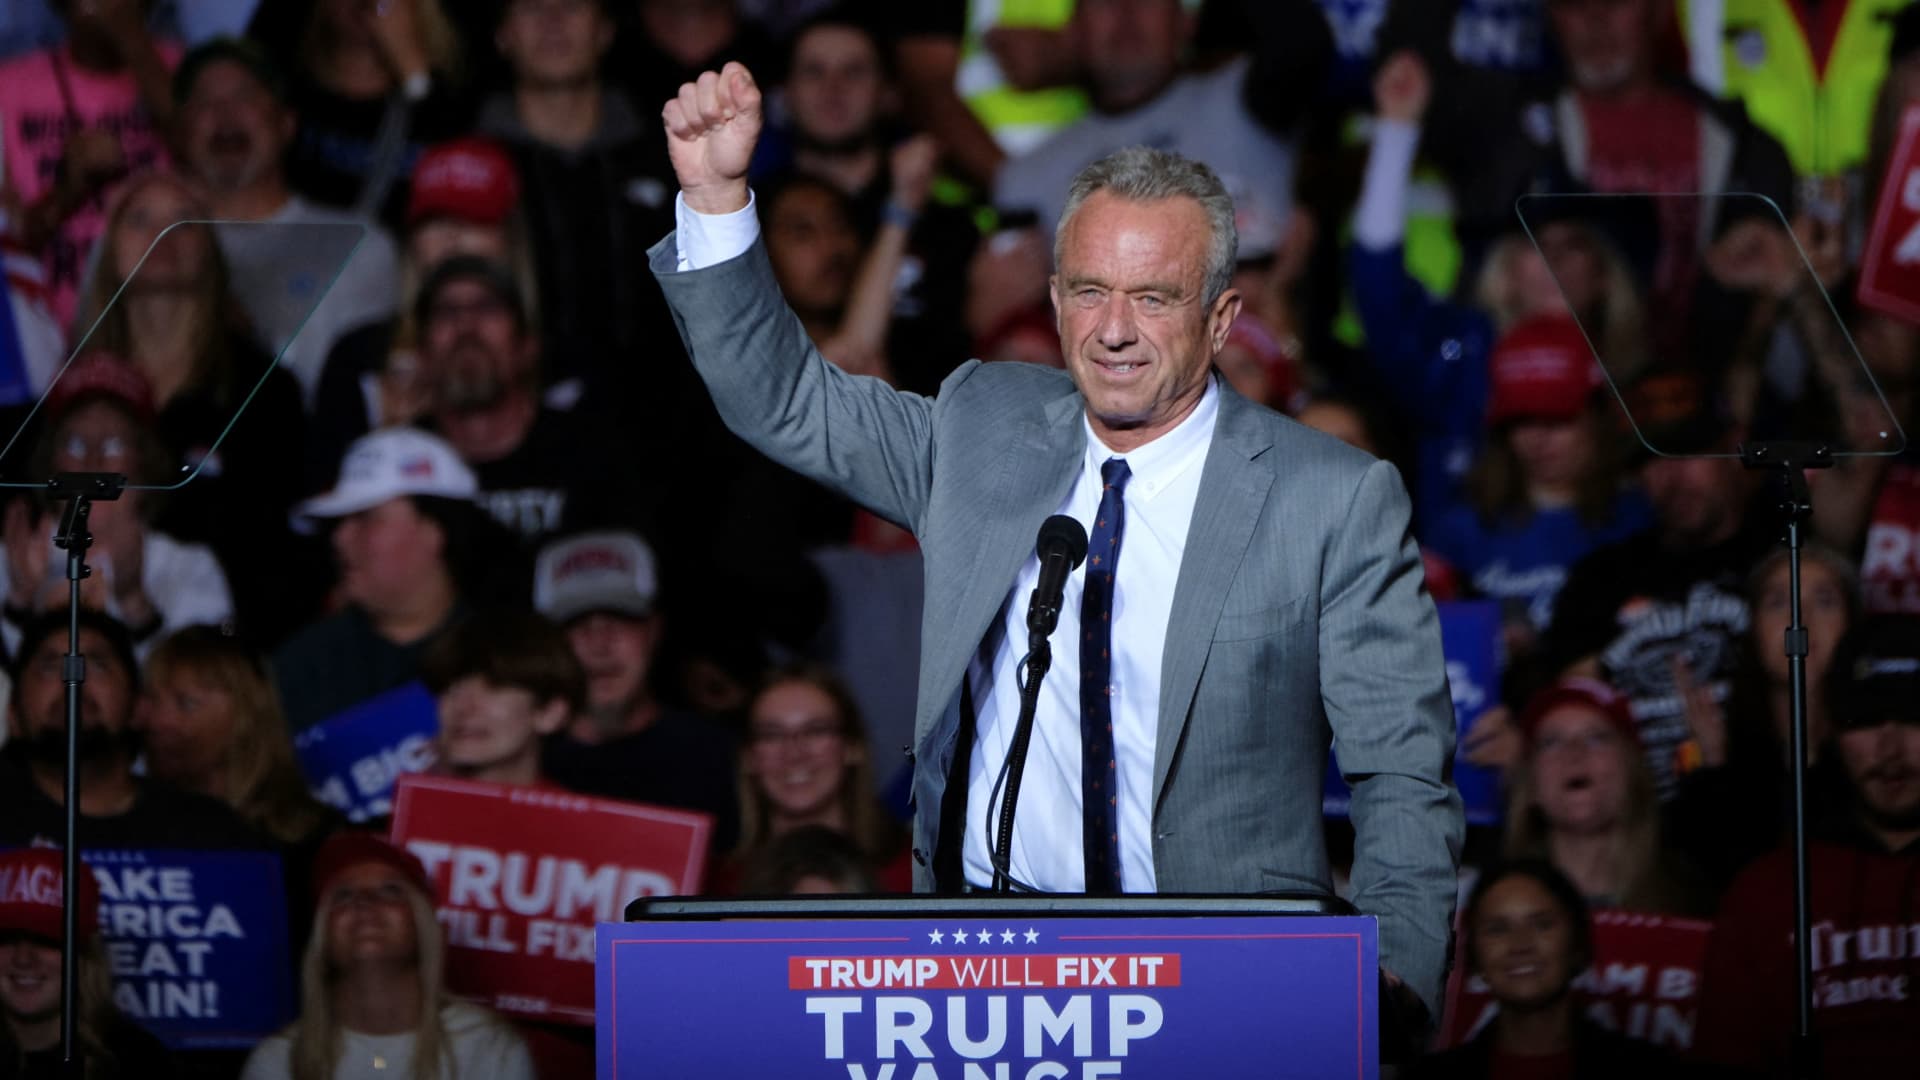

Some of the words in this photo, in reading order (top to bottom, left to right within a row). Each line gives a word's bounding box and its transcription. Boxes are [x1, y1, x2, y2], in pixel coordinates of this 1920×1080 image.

[0, 865, 63, 907] AG
[405, 841, 676, 922] TRUMP
[806, 959, 939, 988] TRUMP
[950, 957, 1044, 987] WILL
[1056, 956, 1120, 986] FIX
[1128, 956, 1164, 986] IT
[806, 994, 1164, 1060] TRUMP
